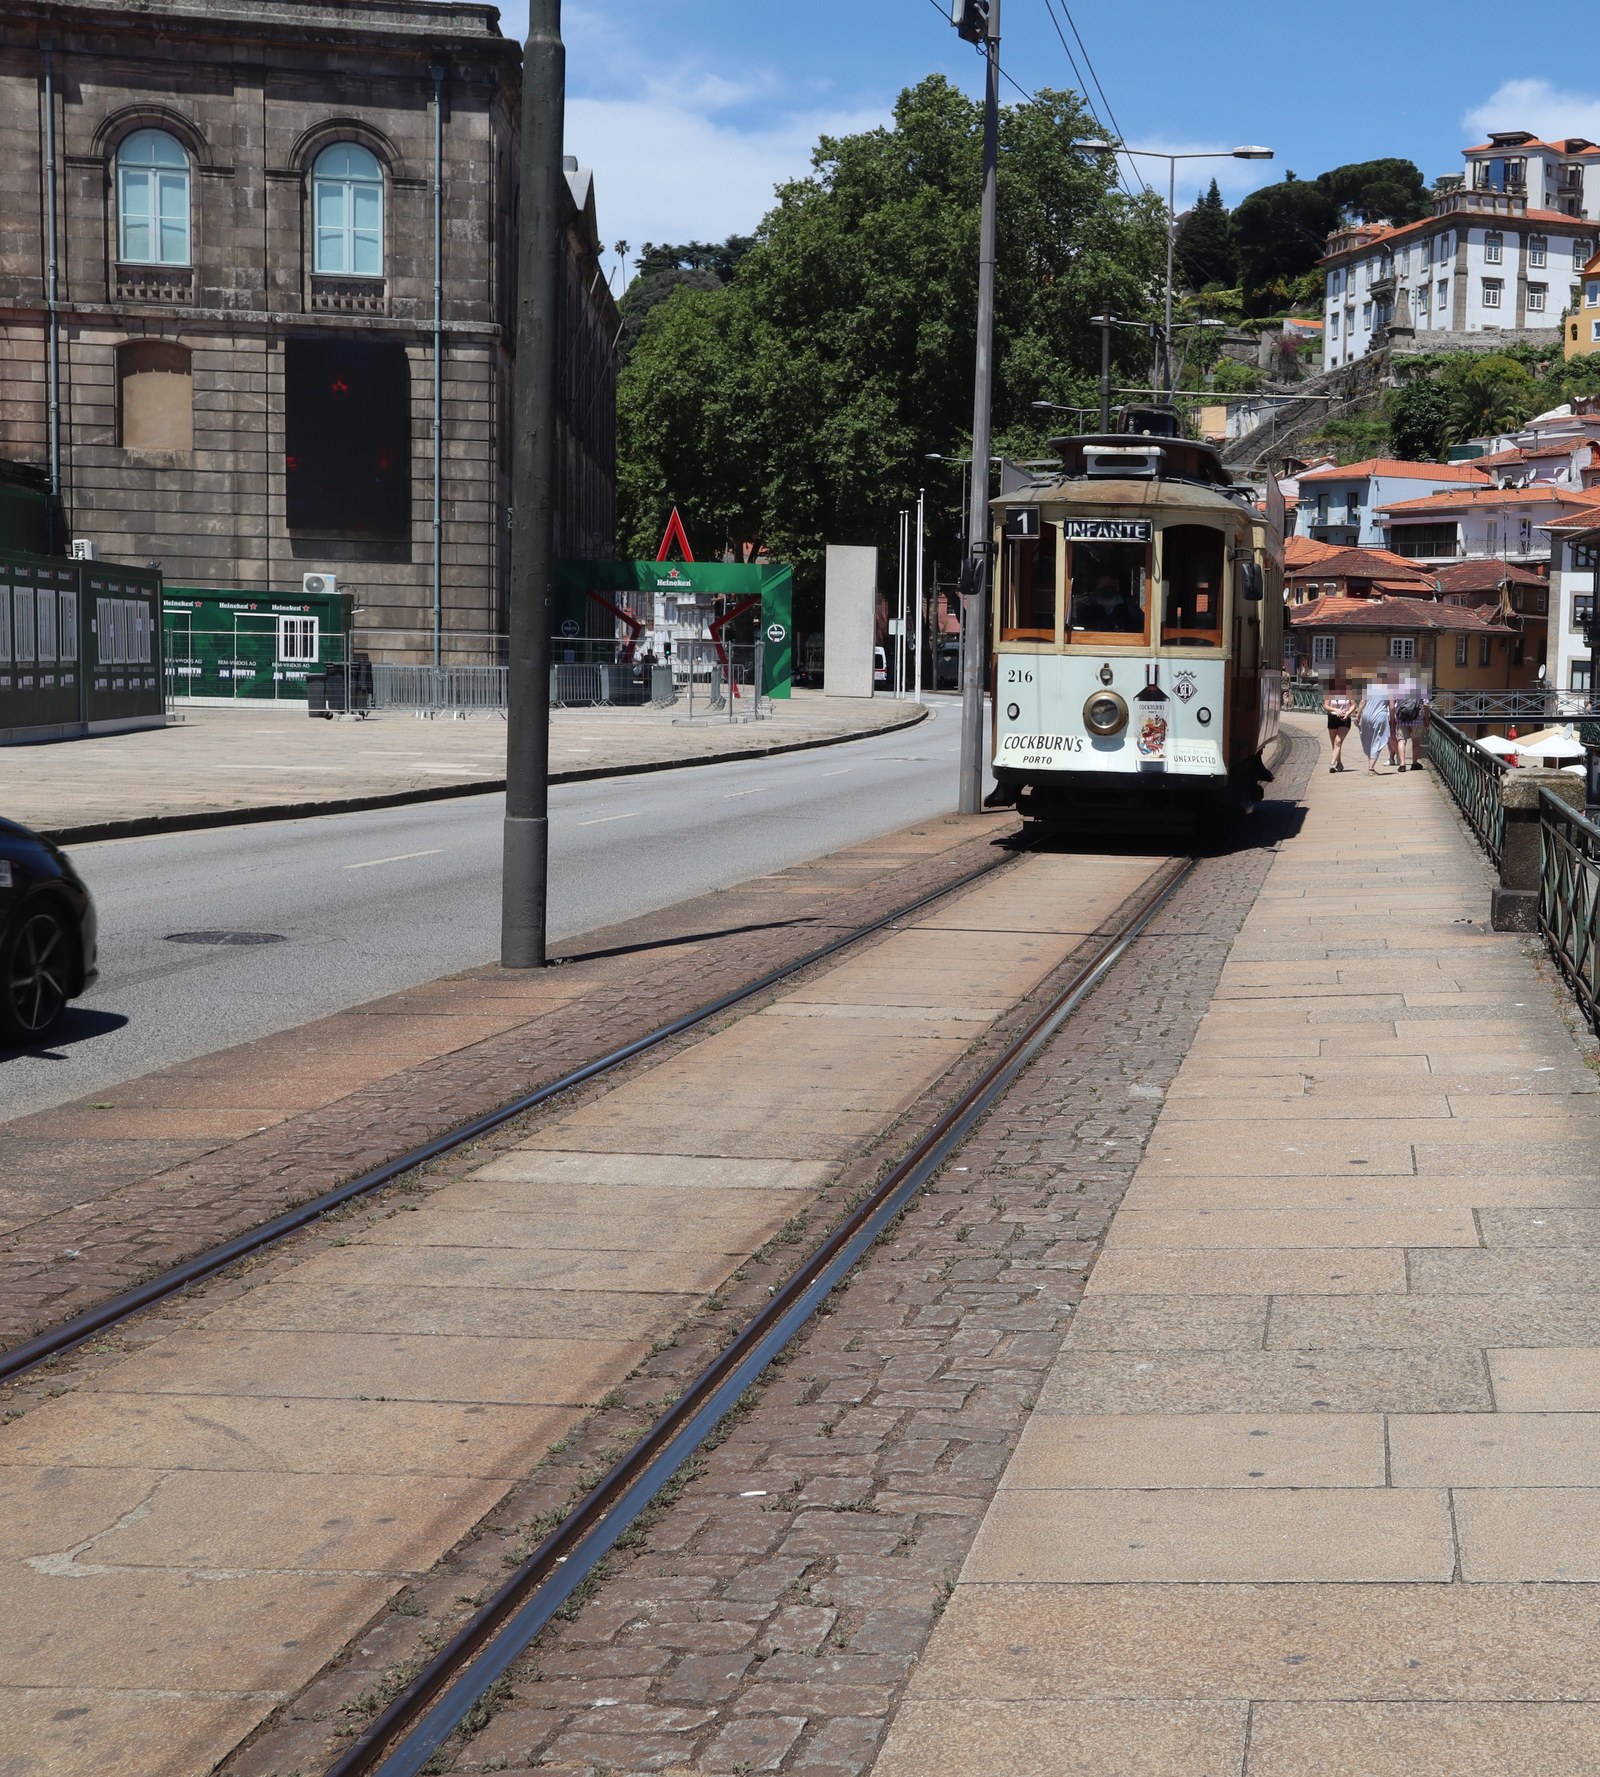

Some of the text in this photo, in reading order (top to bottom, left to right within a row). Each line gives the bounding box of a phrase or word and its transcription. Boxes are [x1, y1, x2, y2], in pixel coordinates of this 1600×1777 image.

[1017, 510, 1029, 534] 1
[1067, 522, 1147, 539] INFANTE
[656, 578, 692, 587] Heineken
[219, 669, 230, 678] JN
[1007, 669, 1033, 683] 216
[1004, 735, 1084, 753] COCKBURN'S
[1022, 755, 1053, 765] PORTO
[1173, 755, 1217, 765] UNEXPECTED
